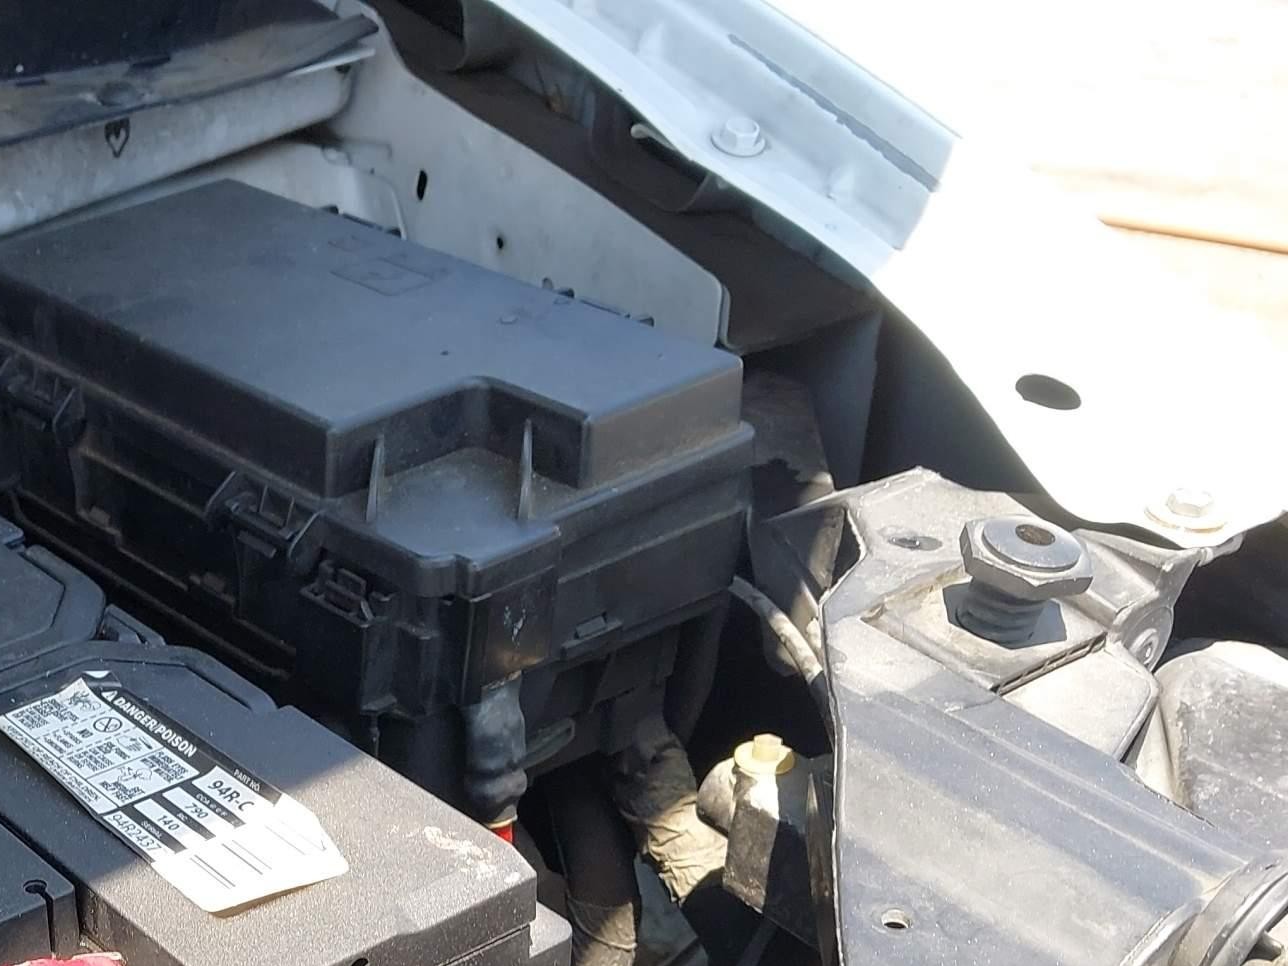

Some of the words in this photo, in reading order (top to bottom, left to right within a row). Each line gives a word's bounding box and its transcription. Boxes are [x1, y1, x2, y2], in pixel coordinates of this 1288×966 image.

[114, 696, 198, 758] DANGER/POISON
[185, 802, 209, 819] 790
[207, 780, 255, 812] 94R-C
[111, 814, 162, 851] 94R2437
[157, 815, 180, 831] 140
